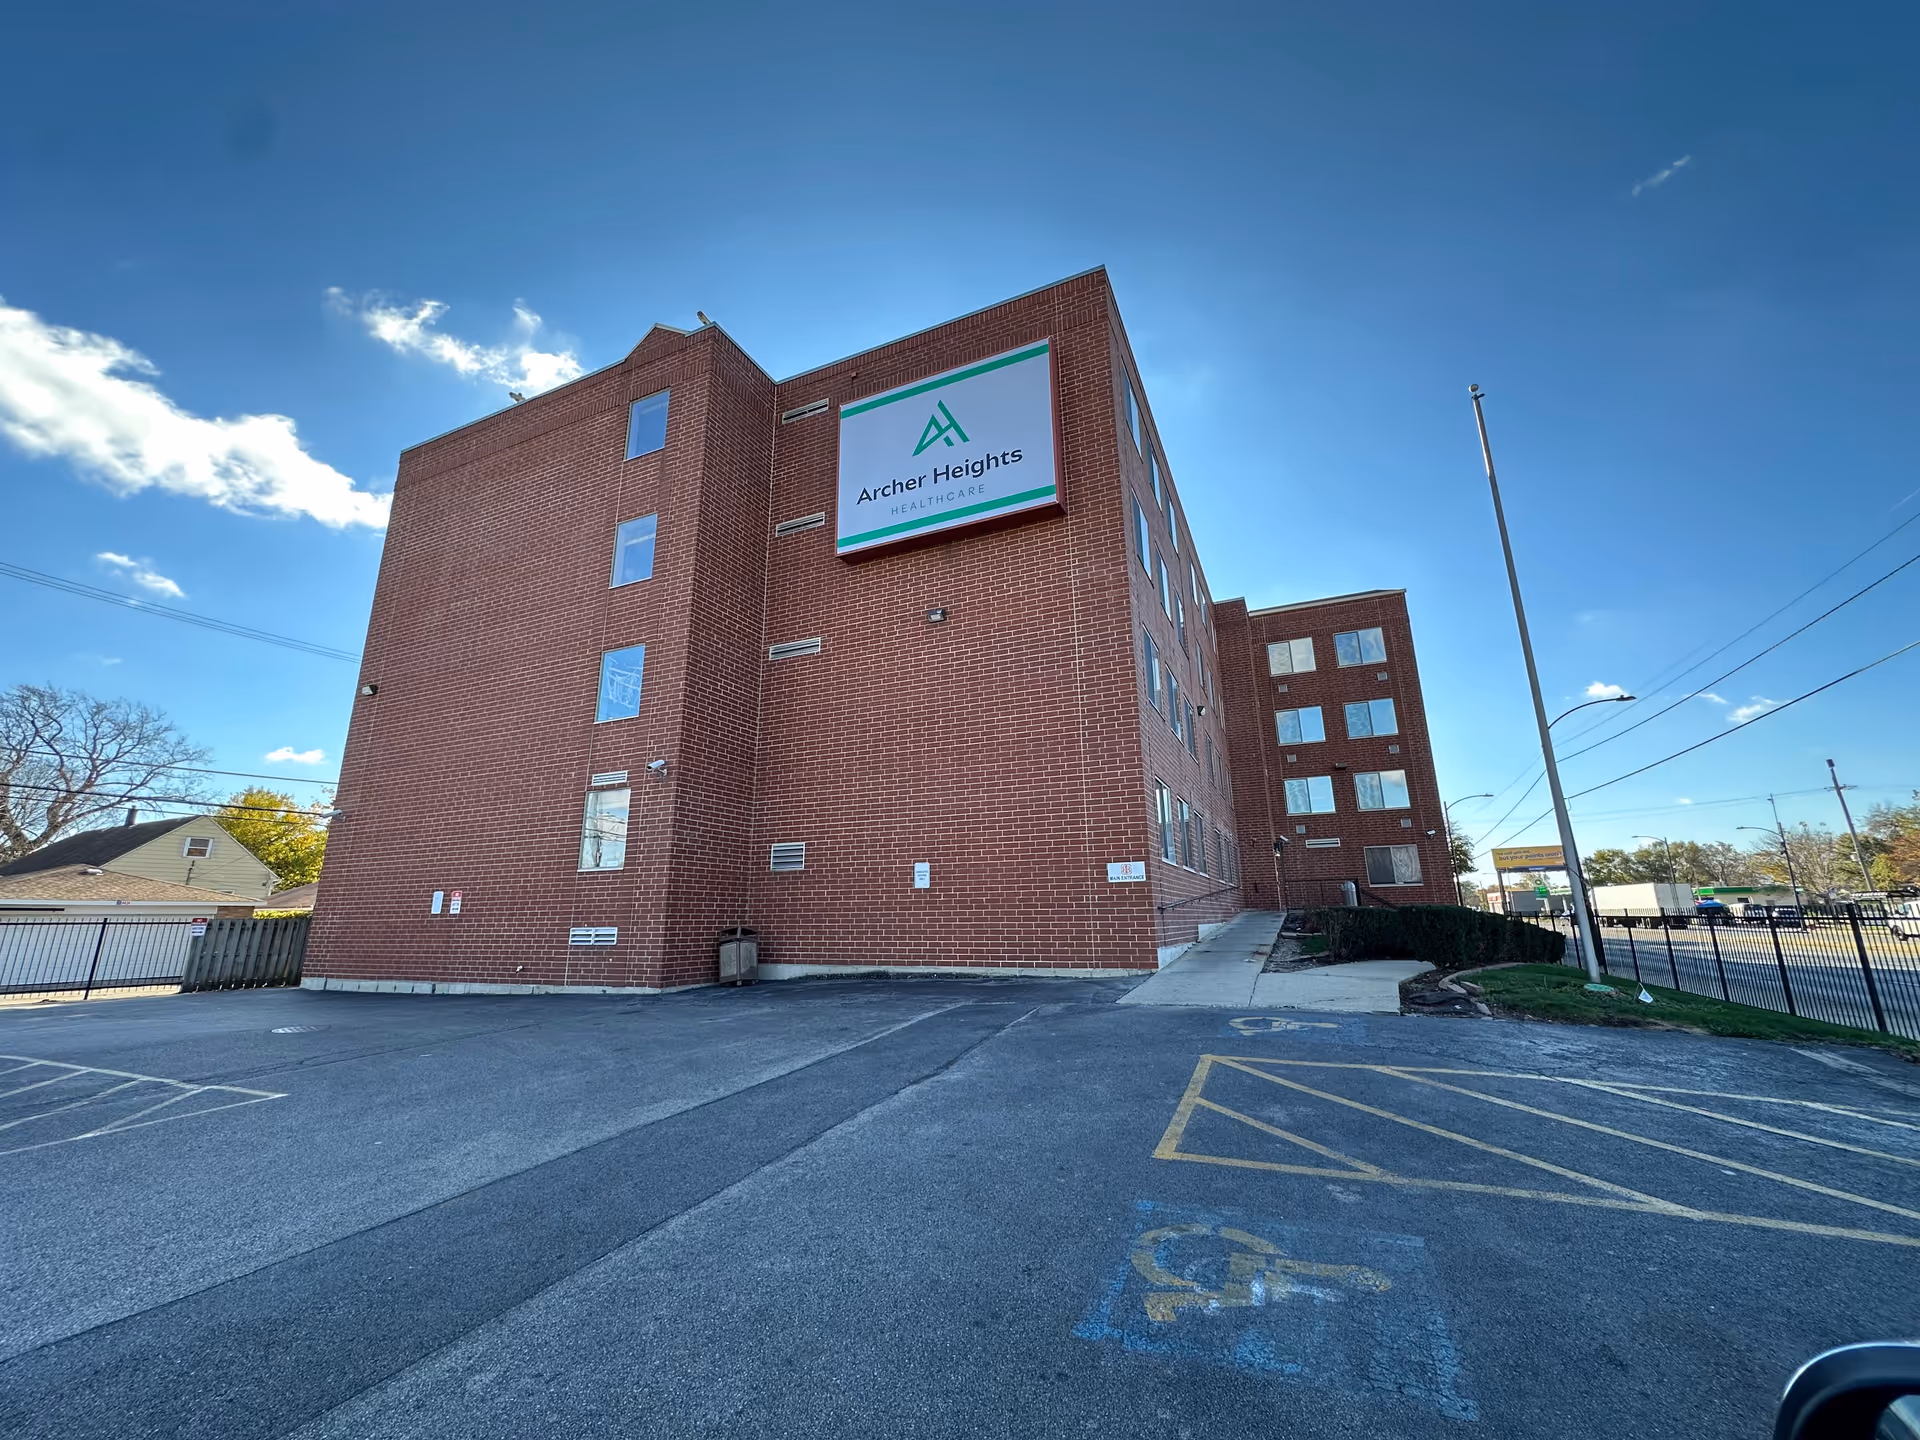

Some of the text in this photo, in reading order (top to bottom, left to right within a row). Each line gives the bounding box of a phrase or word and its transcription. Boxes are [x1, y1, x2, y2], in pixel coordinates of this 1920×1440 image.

[856, 448, 1023, 505] Archer Heights
[891, 484, 985, 515] HEALTHCARE
